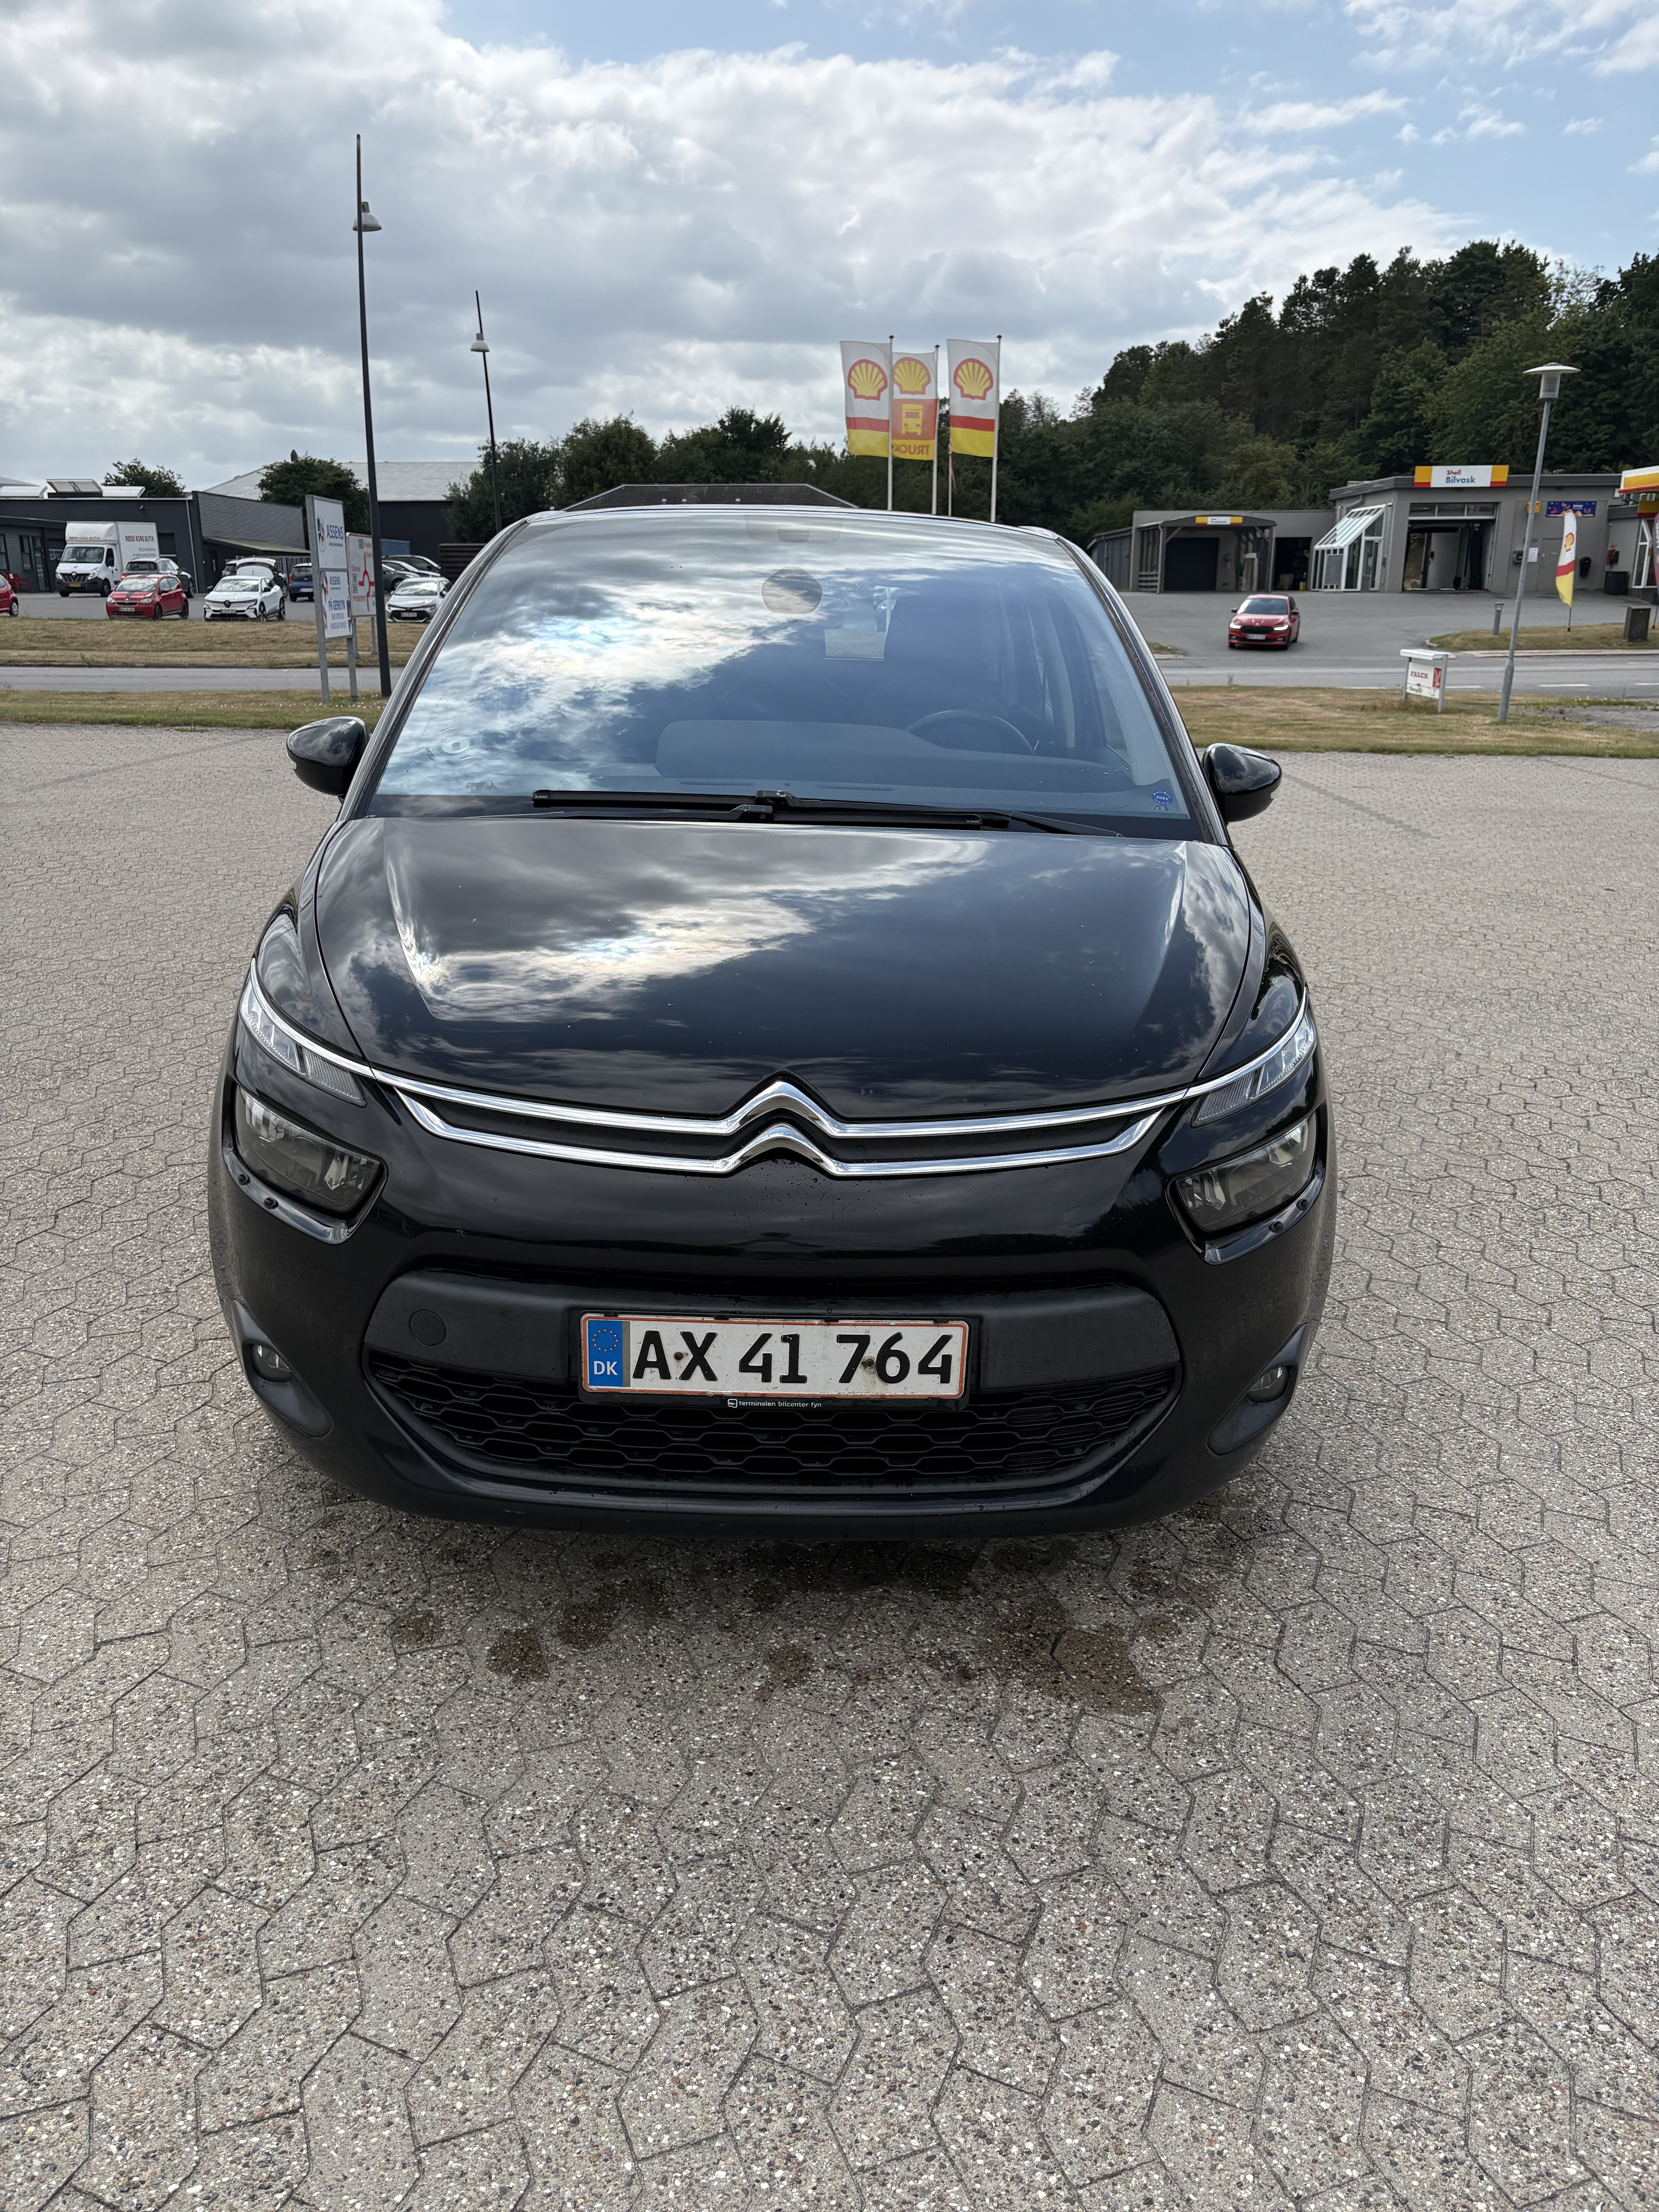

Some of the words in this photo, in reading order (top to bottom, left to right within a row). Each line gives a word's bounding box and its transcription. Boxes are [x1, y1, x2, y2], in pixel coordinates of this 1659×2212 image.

[1445, 475, 1476, 484] Bilvask
[326, 524, 344, 540] ASSENS
[1410, 671, 1429, 679] FALCK
[632, 1330, 718, 1382] AX
[738, 1333, 807, 1383] 41
[836, 1332, 953, 1384] 764
[593, 1360, 618, 1376] DK
